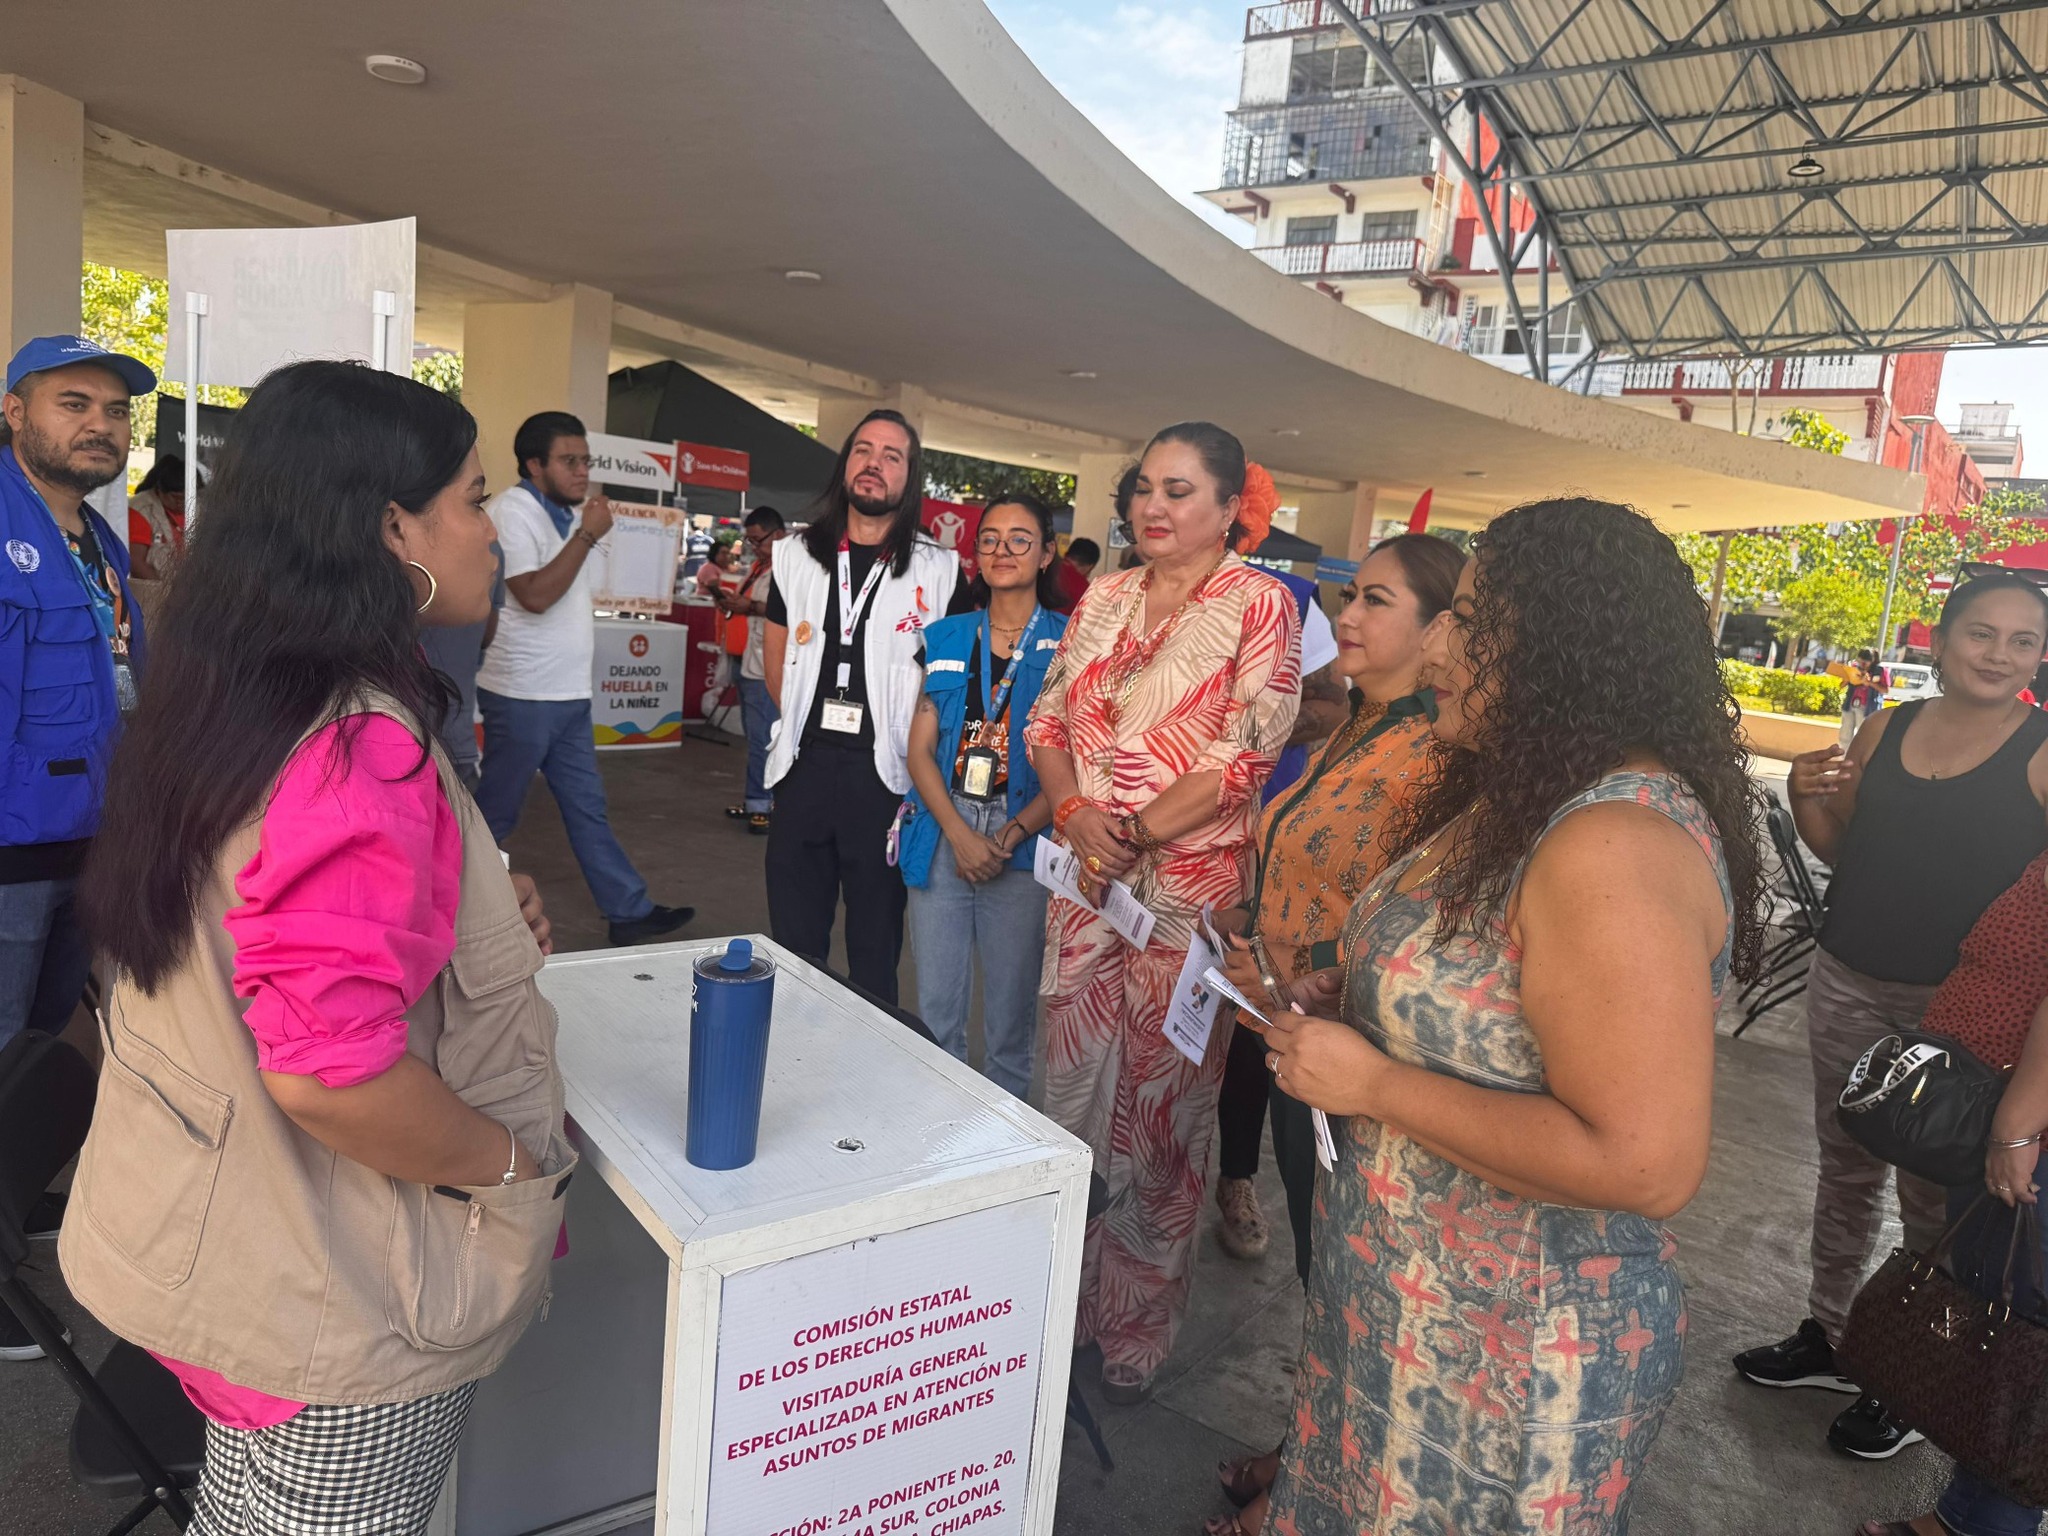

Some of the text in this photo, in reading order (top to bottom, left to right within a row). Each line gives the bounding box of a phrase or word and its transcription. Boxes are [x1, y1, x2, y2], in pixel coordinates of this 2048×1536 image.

[615, 458, 657, 477] Vision
[601, 680, 668, 692] HUELLA EN
[610, 665, 661, 677] DEJANDO
[610, 696, 660, 709] LA NIÑEZ
[738, 1298, 1013, 1391] DE LOS DERECHOS HUMANOS
[793, 1285, 972, 1347] COMISIÓN ESTATAL
[726, 1353, 1028, 1460] ESPECIALIZADA EN ATENCIÓN DE
[782, 1341, 988, 1416] VISITADURÍA GENERAL
[763, 1388, 995, 1477] ASUNTOS DE MIGRANTES
[837, 1505, 862, 1525] 2A
[867, 1470, 956, 1514] PONIENTE
[960, 1463, 988, 1482] No.
[993, 1450, 1016, 1470] 20,
[880, 1510, 920, 1535] SUR,
[925, 1478, 1000, 1517] COLONIA
[930, 1500, 1006, 1536] CHIAPAS.
